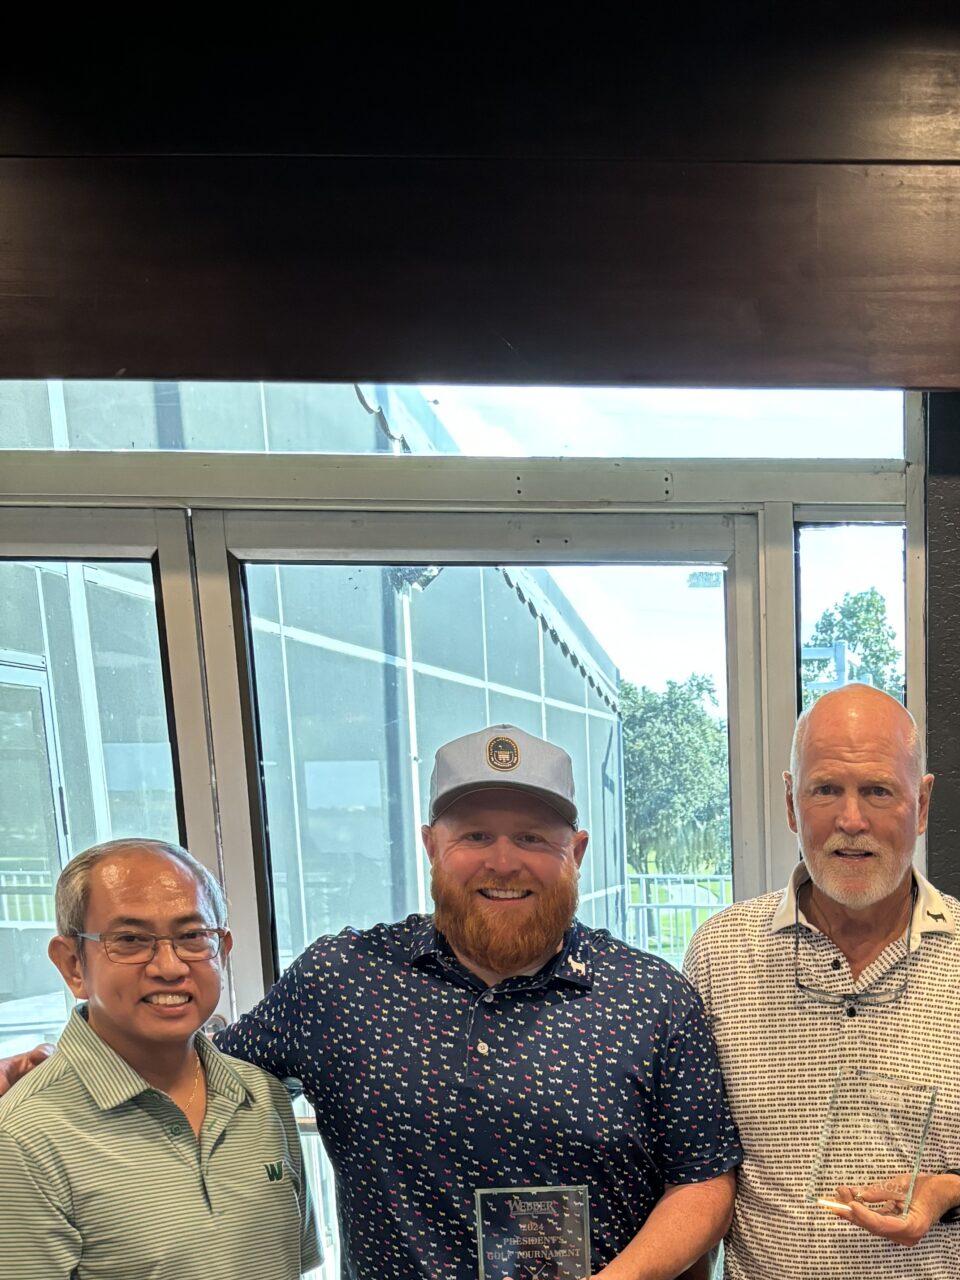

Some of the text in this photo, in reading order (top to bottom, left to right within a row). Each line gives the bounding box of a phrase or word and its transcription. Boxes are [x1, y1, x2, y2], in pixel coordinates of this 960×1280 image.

[264, 1160, 284, 1182] W
[508, 1200, 557, 1215] WEBBER
[521, 1222, 544, 1231] 2024
[487, 1249, 580, 1260] GOLF TOURNAMENT
